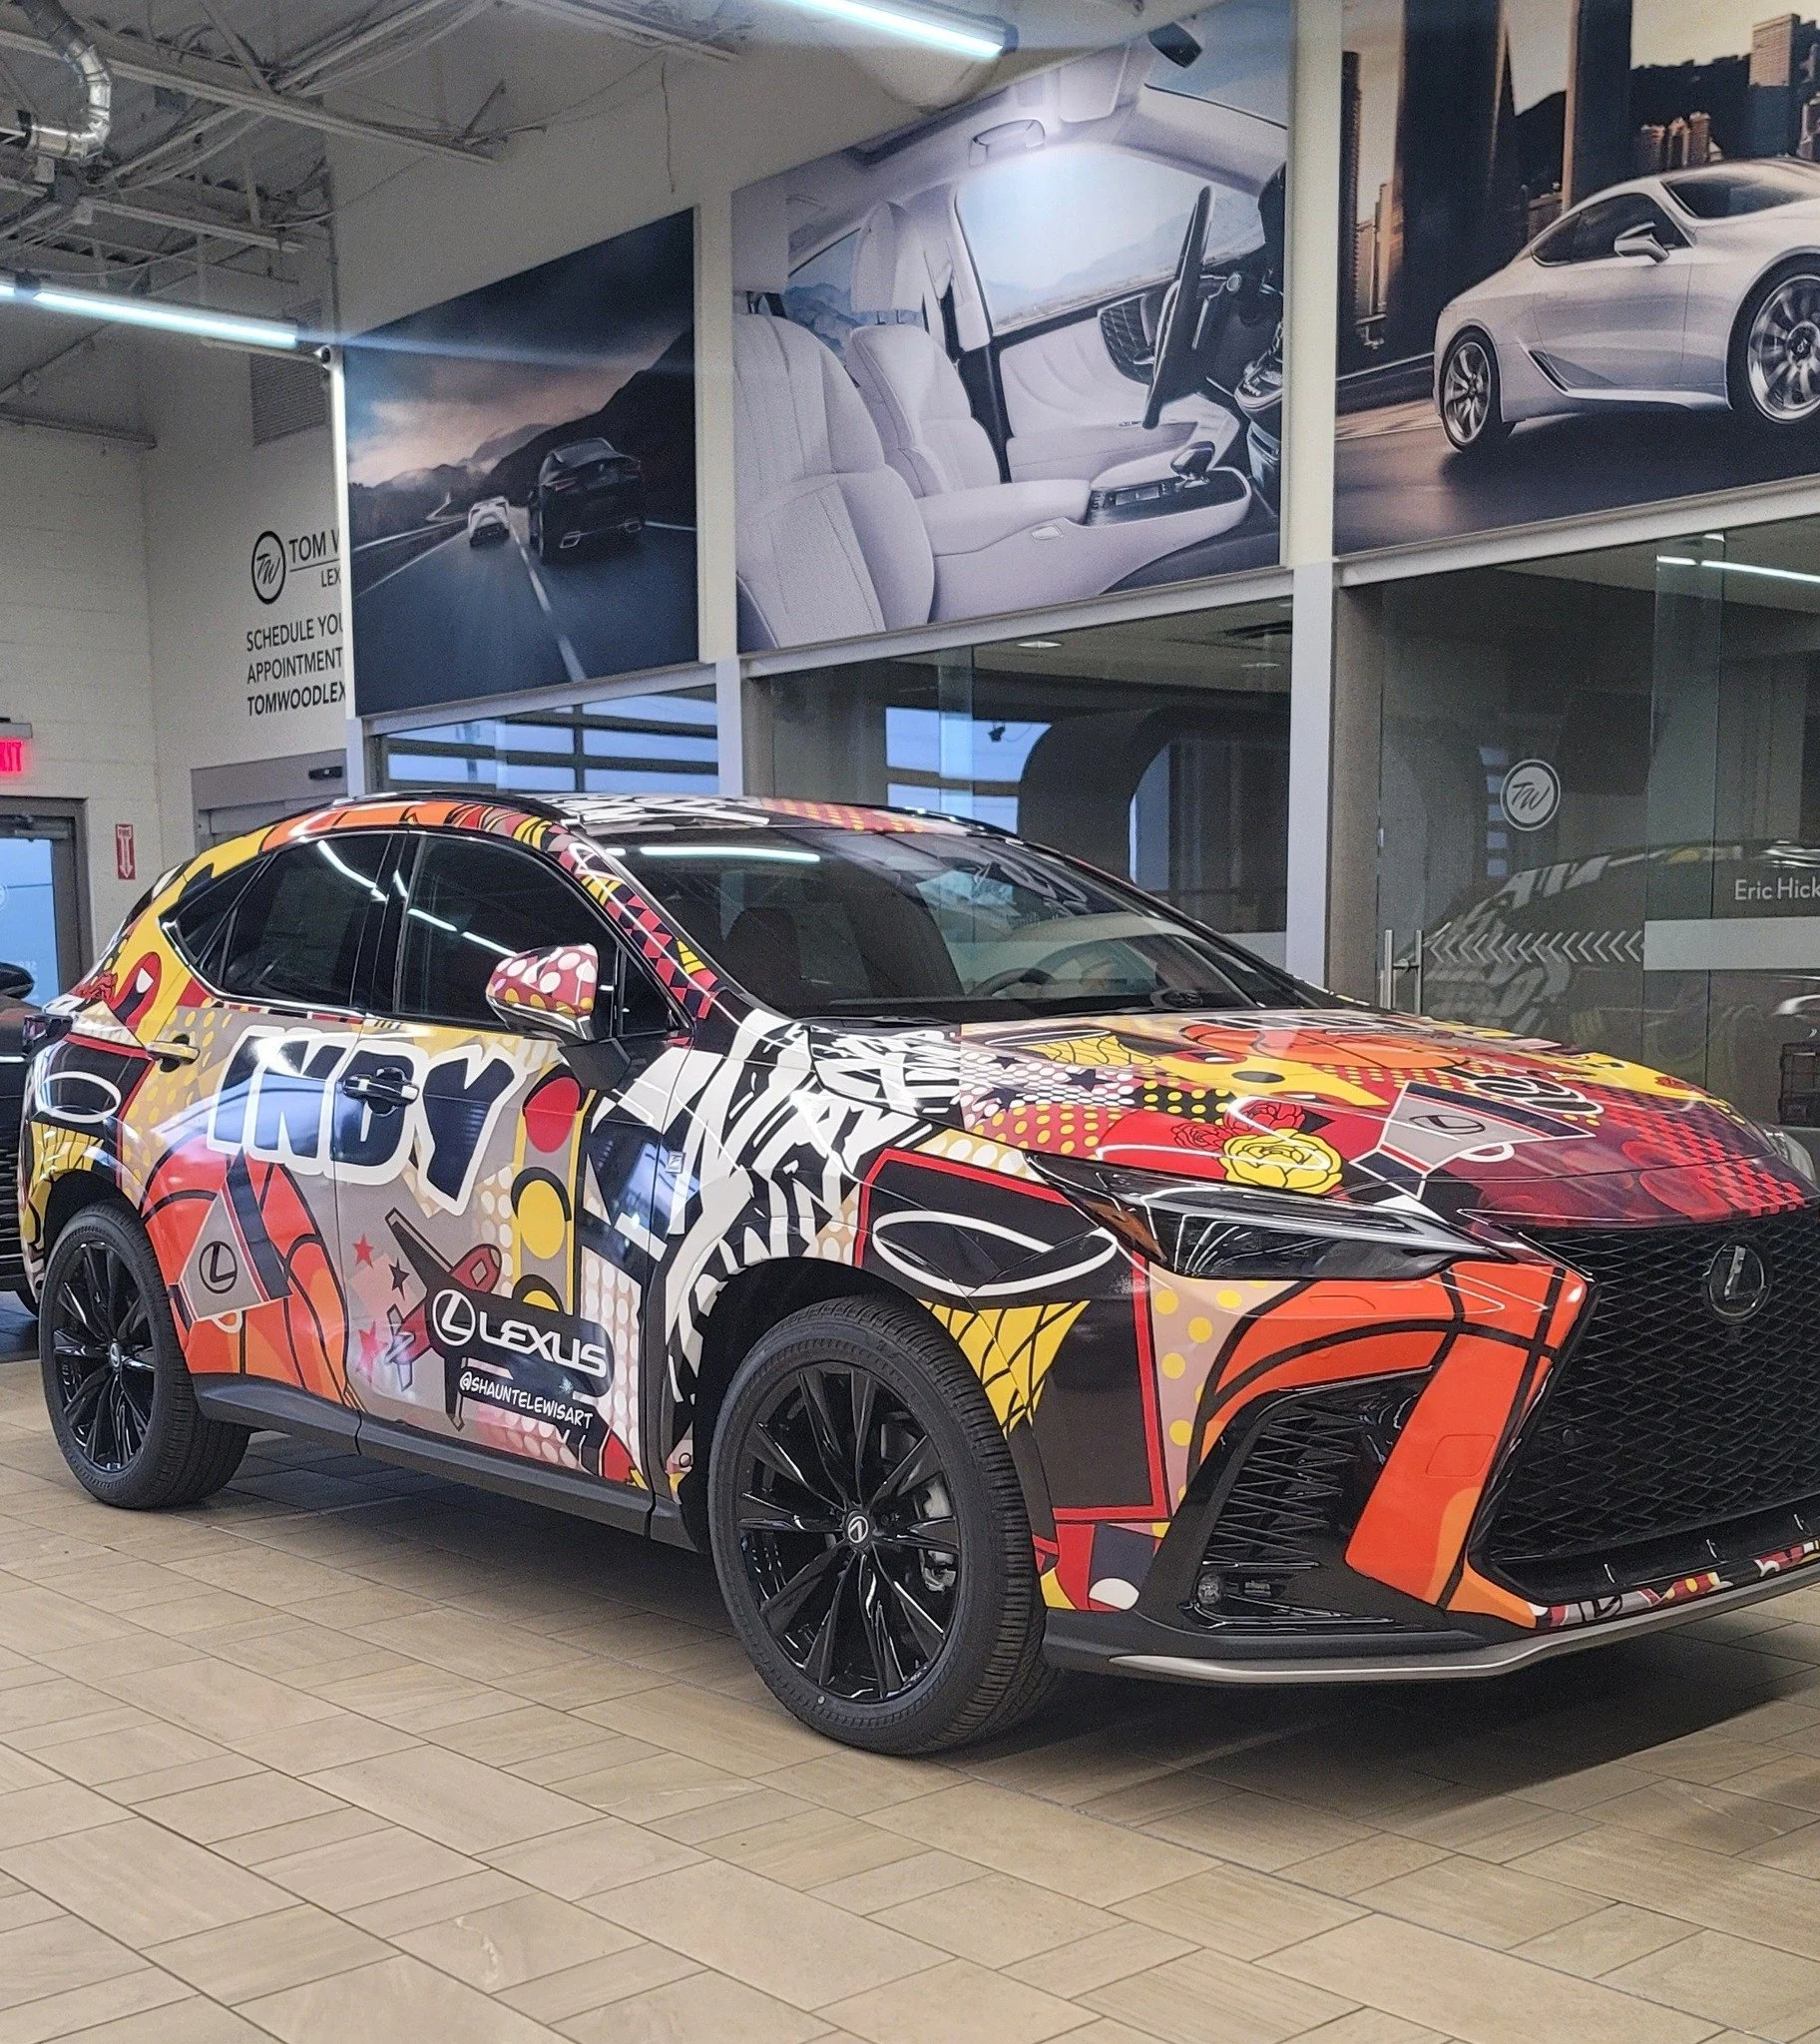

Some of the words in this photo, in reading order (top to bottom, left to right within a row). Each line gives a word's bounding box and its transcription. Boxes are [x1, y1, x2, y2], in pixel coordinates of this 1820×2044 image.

[288, 531, 326, 564] TOM
[245, 618, 315, 653] SCHEDULE
[246, 646, 343, 686] APPOINTMENT
[247, 681, 346, 717] TOMWOODLEX
[1734, 878, 1773, 901] Eric
[208, 1026, 523, 1216] INDY
[479, 1310, 607, 1378] LEXUS
[459, 1370, 594, 1429] @SHAUNTELEWISART
